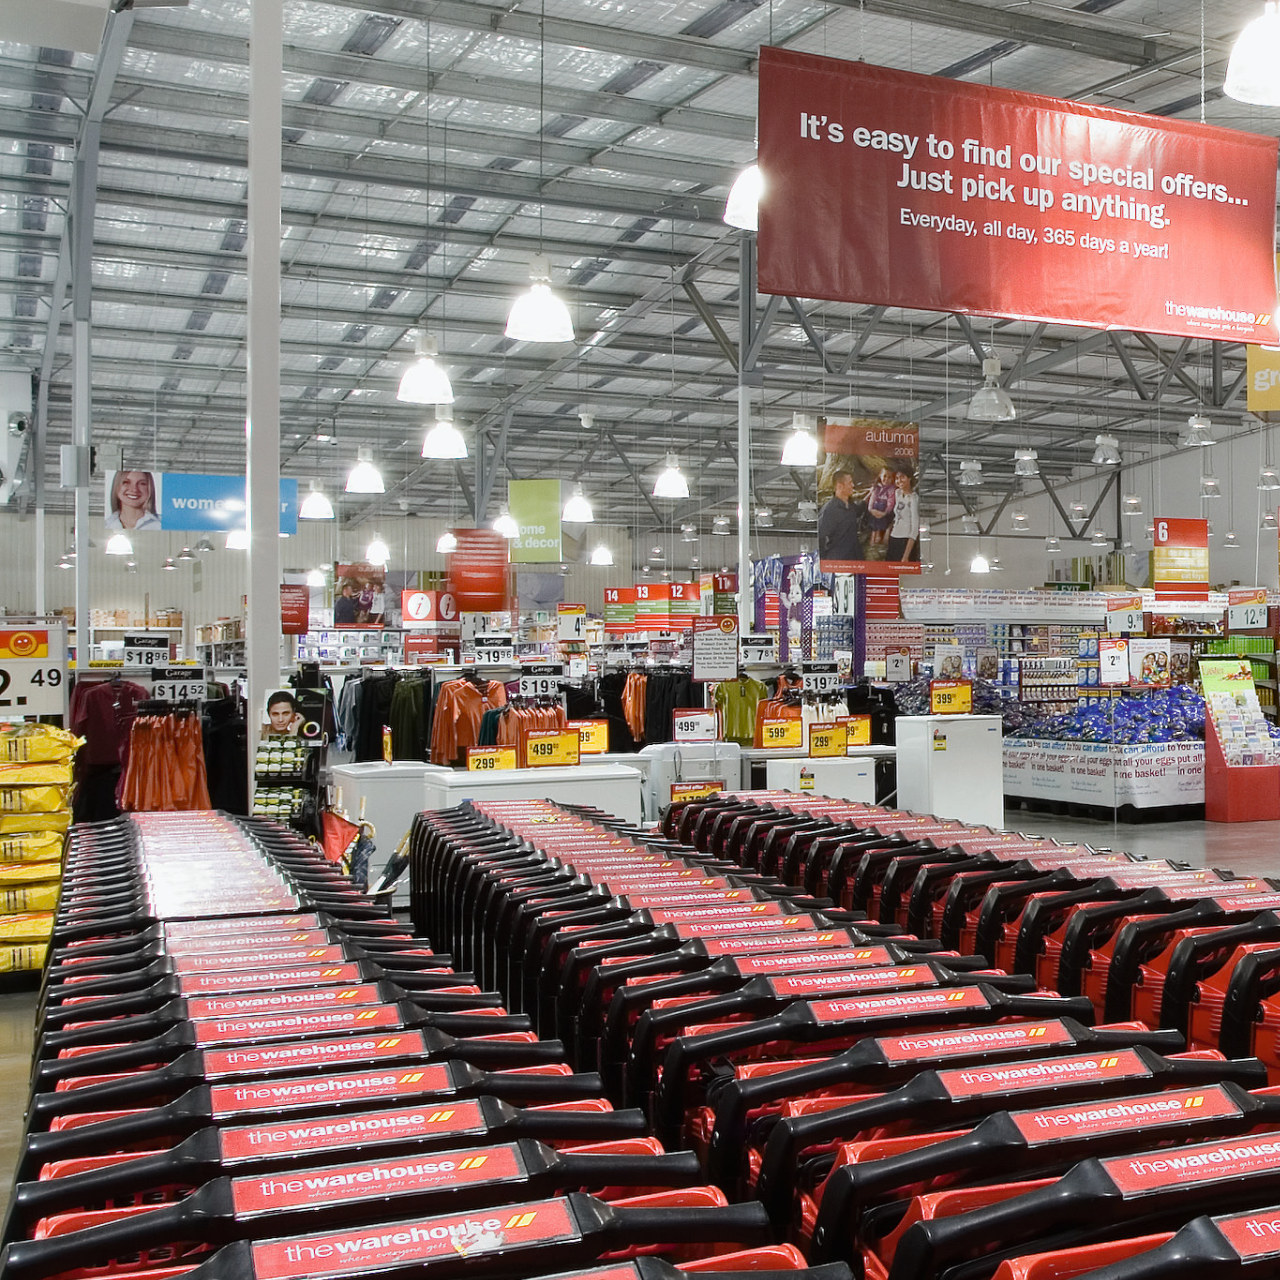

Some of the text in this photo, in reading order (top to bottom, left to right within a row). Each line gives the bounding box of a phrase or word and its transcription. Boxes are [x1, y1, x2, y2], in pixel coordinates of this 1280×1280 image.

[800, 113, 1249, 207] It's easy to find our special offers...
[897, 164, 1171, 229] Just pick up anything.
[900, 208, 1170, 260] Everyday, all day, 365 days a year!
[865, 429, 914, 445] autumn
[895, 447, 914, 457] 2006
[519, 525, 546, 535] ome
[1158, 521, 1168, 541] 6
[525, 537, 560, 549] decor
[718, 577, 728, 590] 11
[606, 589, 619, 602] 14
[636, 586, 649, 599] 13
[671, 585, 683, 598] 12
[1124, 746, 1139, 754] can
[1141, 744, 1165, 753] afford
[1123, 753, 1203, 767] all your eggs put all
[1135, 768, 1166, 778] basket!
[1187, 767, 1202, 775] one
